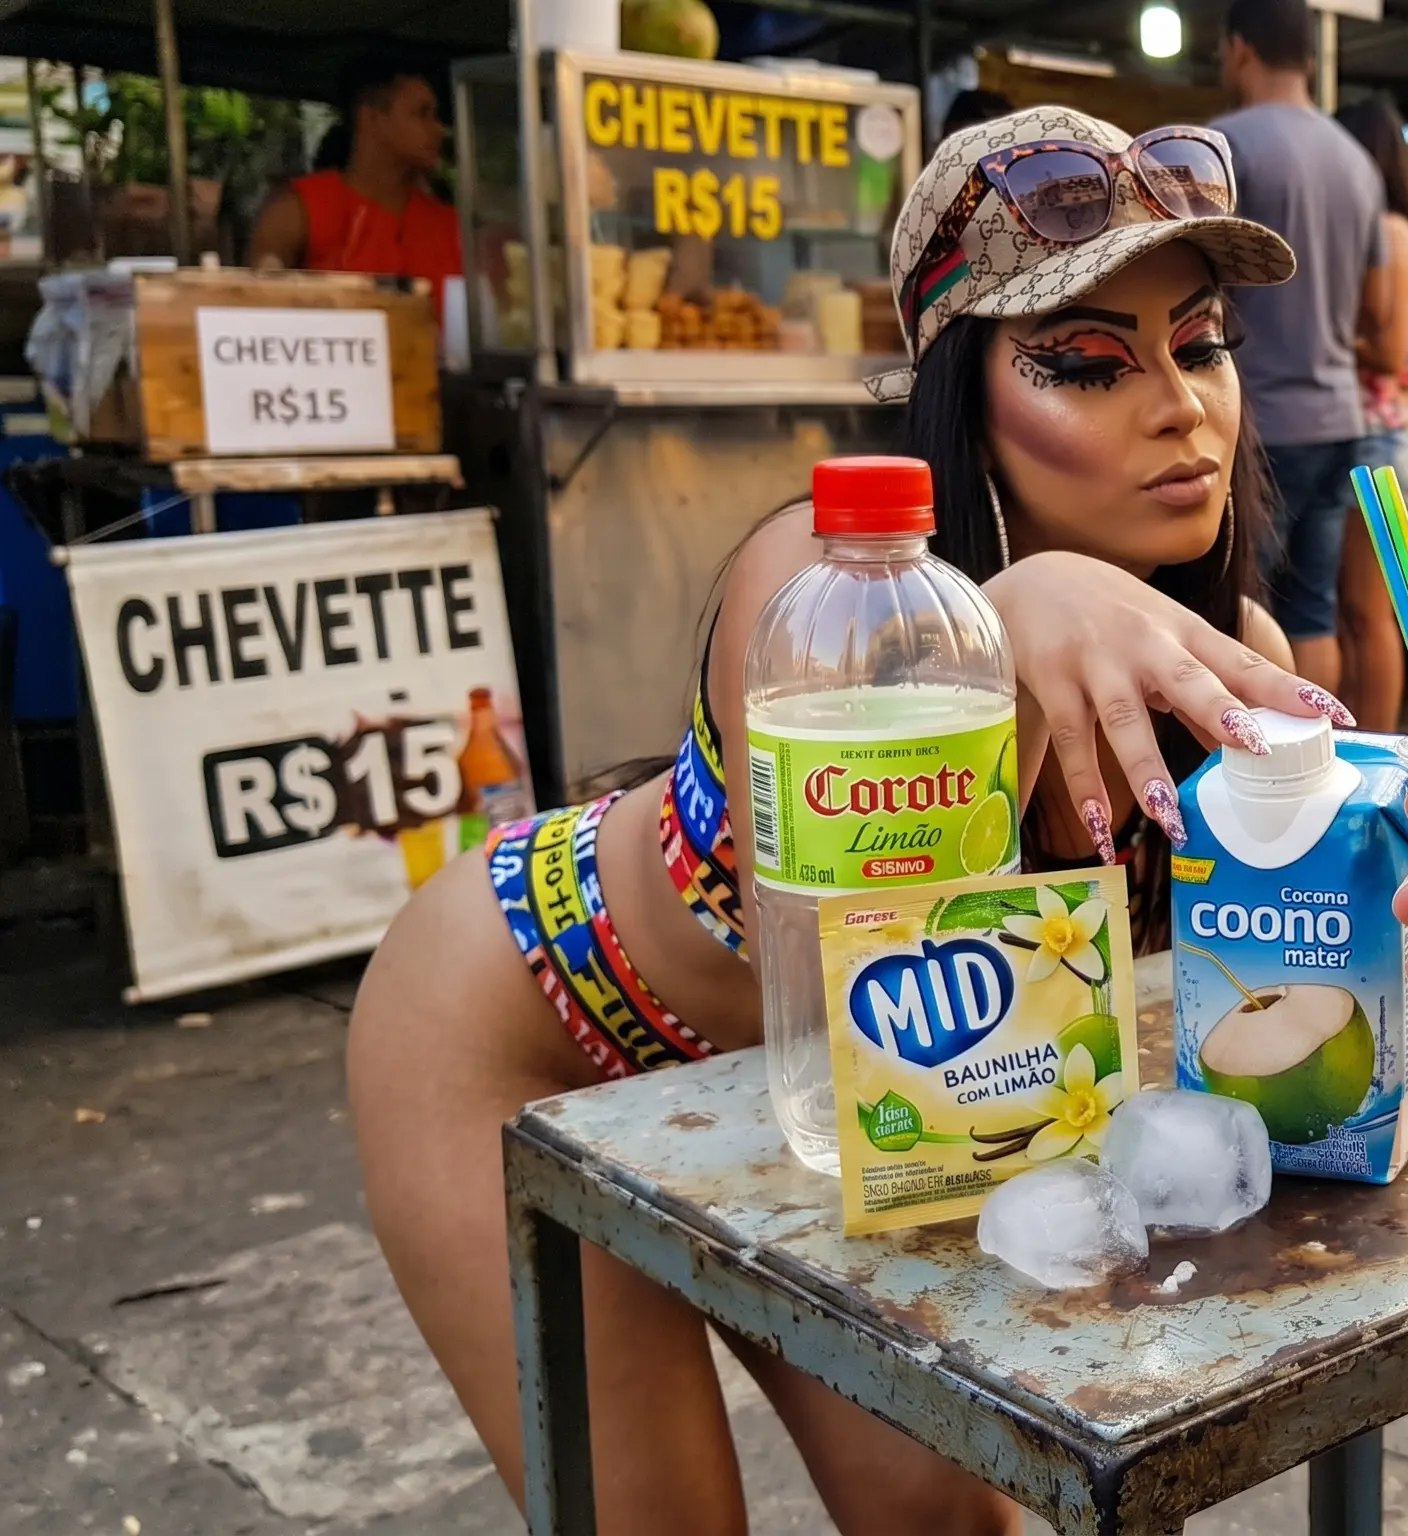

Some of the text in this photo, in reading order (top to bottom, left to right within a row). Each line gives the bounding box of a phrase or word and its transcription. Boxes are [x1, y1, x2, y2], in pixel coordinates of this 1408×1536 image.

[584, 79, 852, 168] CHEVETTE
[652, 167, 783, 241] R$15
[213, 335, 379, 367] CHEVETTE
[252, 387, 349, 426] R$15
[115, 564, 483, 694] CHEVETTE
[214, 719, 464, 848] R$15
[804, 763, 977, 817] Corote
[844, 821, 943, 854] Limão
[1280, 886, 1350, 906] Cocona
[1284, 946, 1351, 969] mater
[866, 952, 1004, 1058] MID
[943, 1041, 1060, 1089] BAUNILHA
[956, 1066, 1057, 1106] COM LIMÃO
